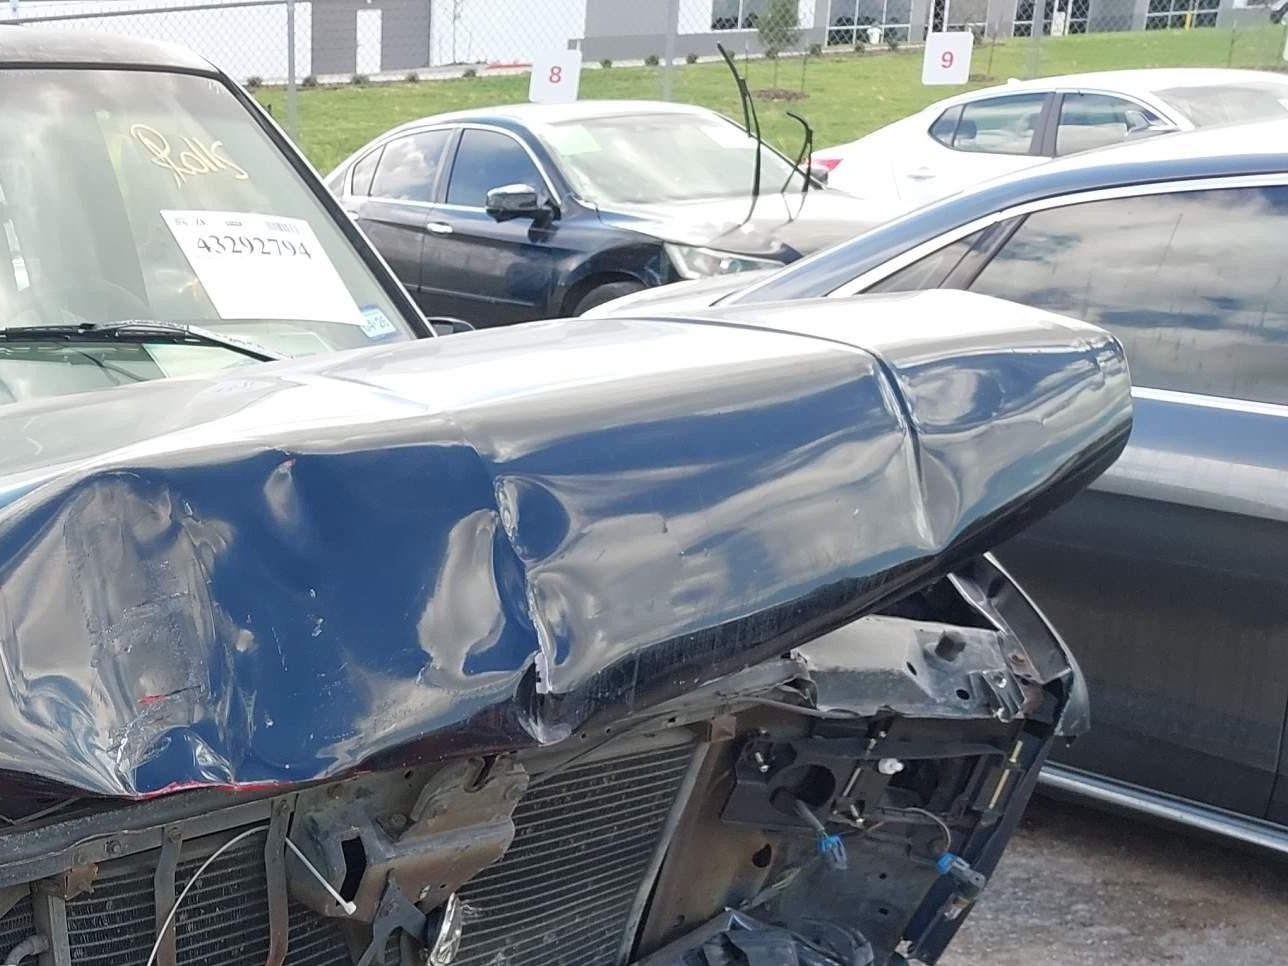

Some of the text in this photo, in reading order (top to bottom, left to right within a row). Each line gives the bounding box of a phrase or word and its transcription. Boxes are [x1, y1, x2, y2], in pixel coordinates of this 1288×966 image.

[941, 50, 954, 69] 9
[548, 65, 562, 84] 8
[196, 235, 312, 259] 43292794
